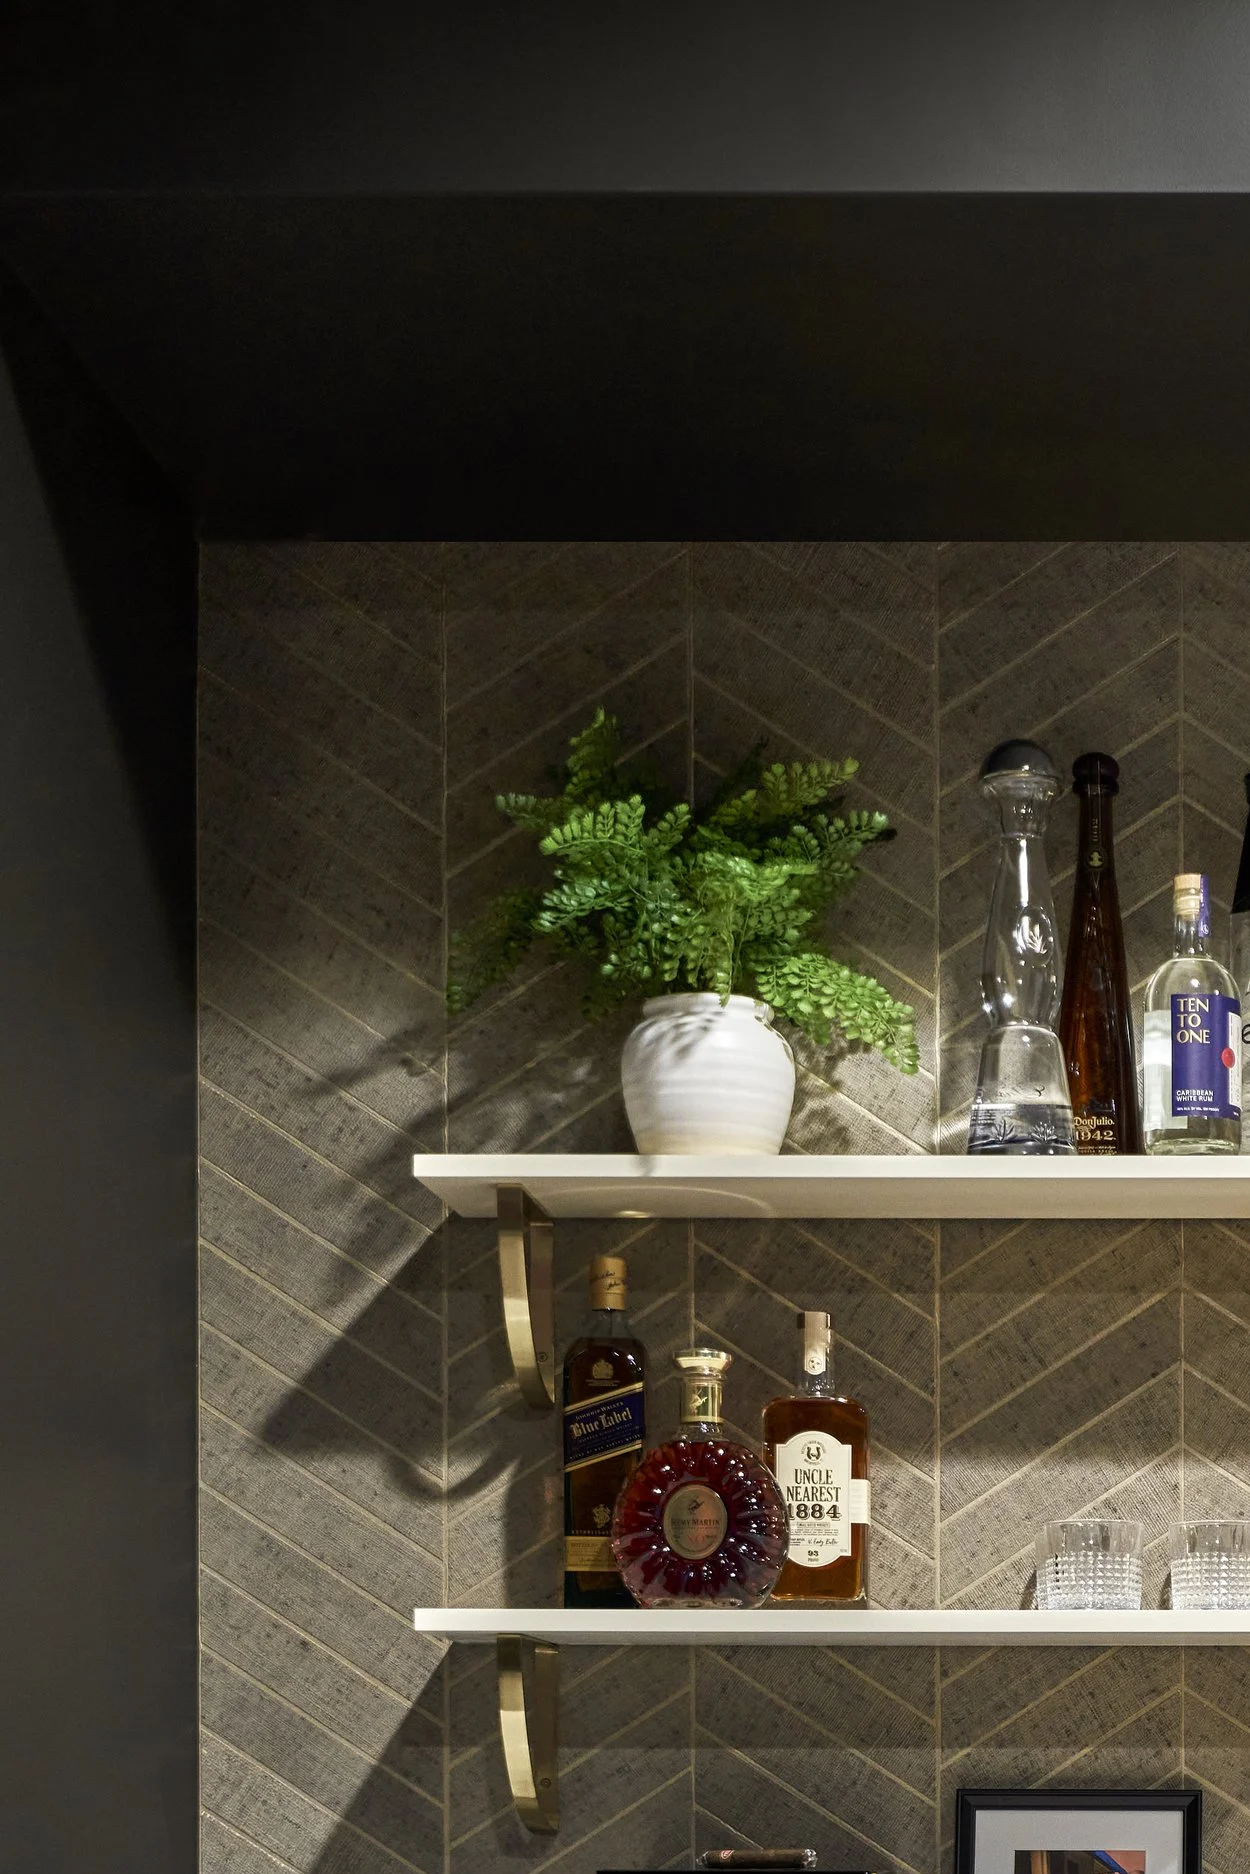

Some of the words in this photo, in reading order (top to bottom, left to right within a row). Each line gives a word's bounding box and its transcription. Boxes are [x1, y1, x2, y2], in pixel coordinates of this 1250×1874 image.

[1177, 997, 1209, 1013] TEN
[1176, 1013, 1201, 1028] TO
[1176, 1029, 1210, 1044] ONE
[569, 1421, 600, 1439] Blue
[600, 1407, 633, 1430] Label
[794, 1468, 834, 1485] UNCLE
[786, 1485, 842, 1502] NEAREST
[787, 1503, 842, 1521] 1884
[807, 1549, 819, 1557] 93
